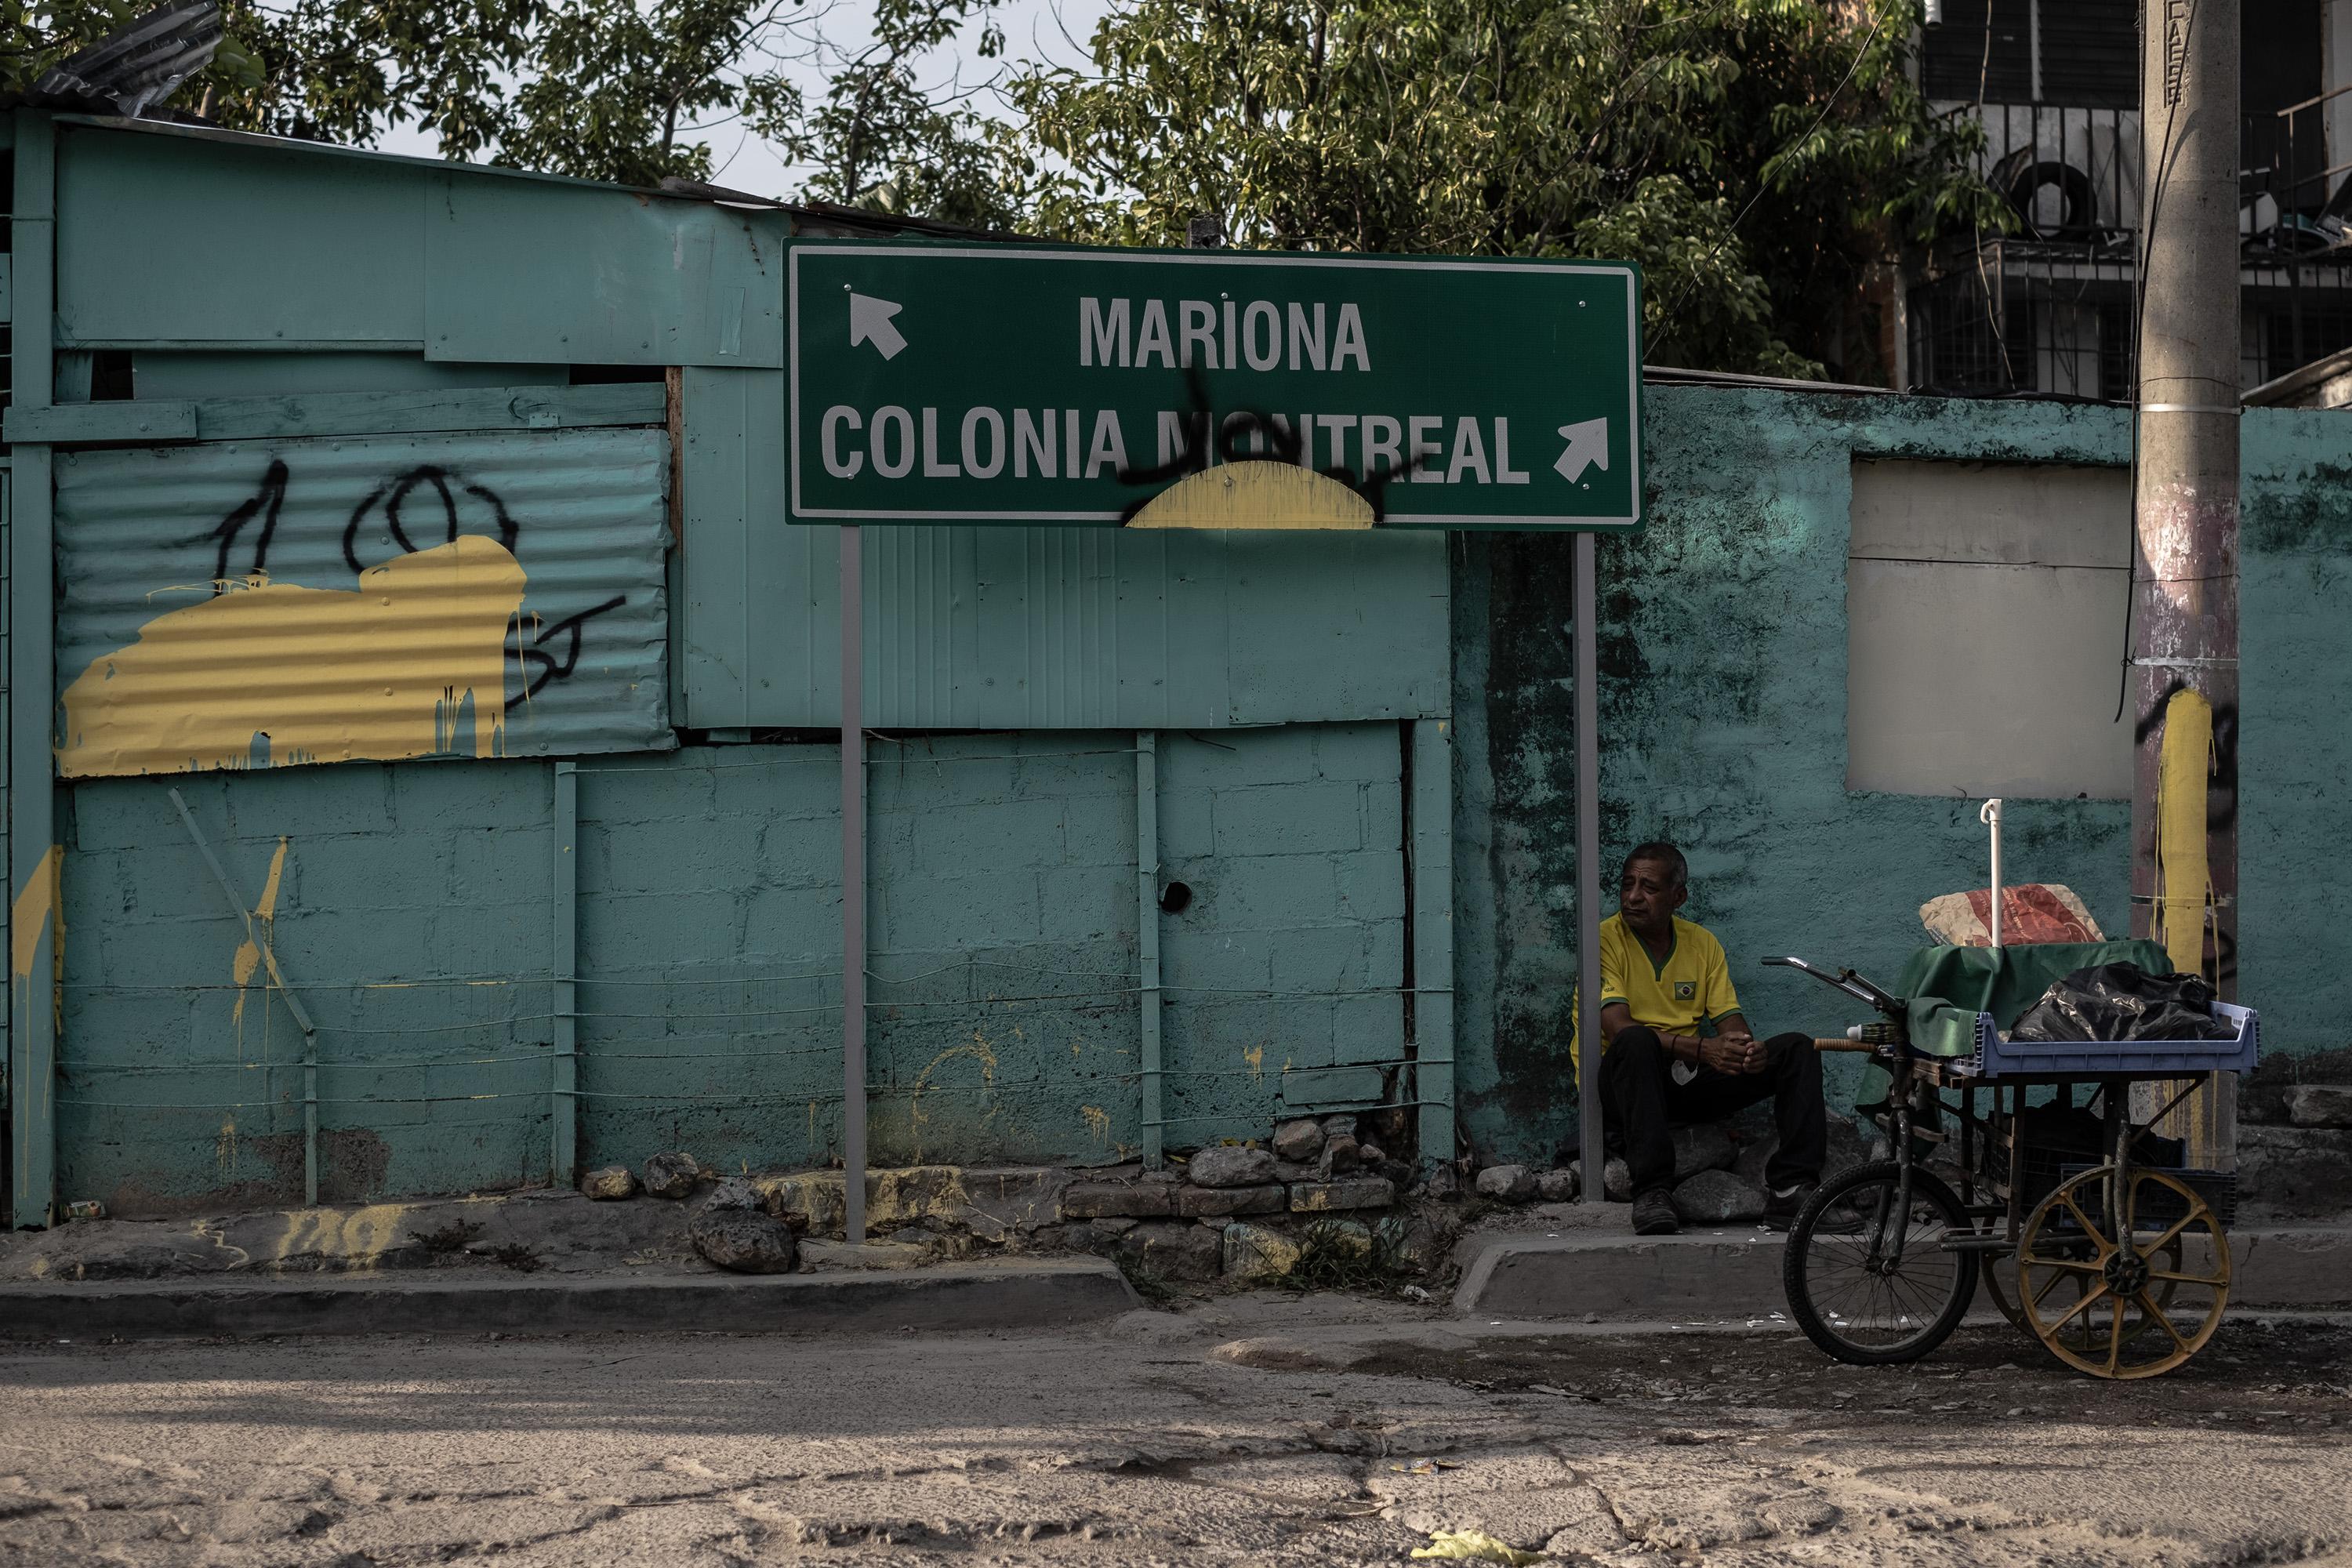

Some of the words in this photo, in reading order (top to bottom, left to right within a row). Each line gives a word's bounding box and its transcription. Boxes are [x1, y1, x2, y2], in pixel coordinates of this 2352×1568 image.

[1079, 296, 1371, 372] MARIONA
[821, 404, 1127, 480] COLONIA
[1157, 409, 1530, 485] MONTREAL
